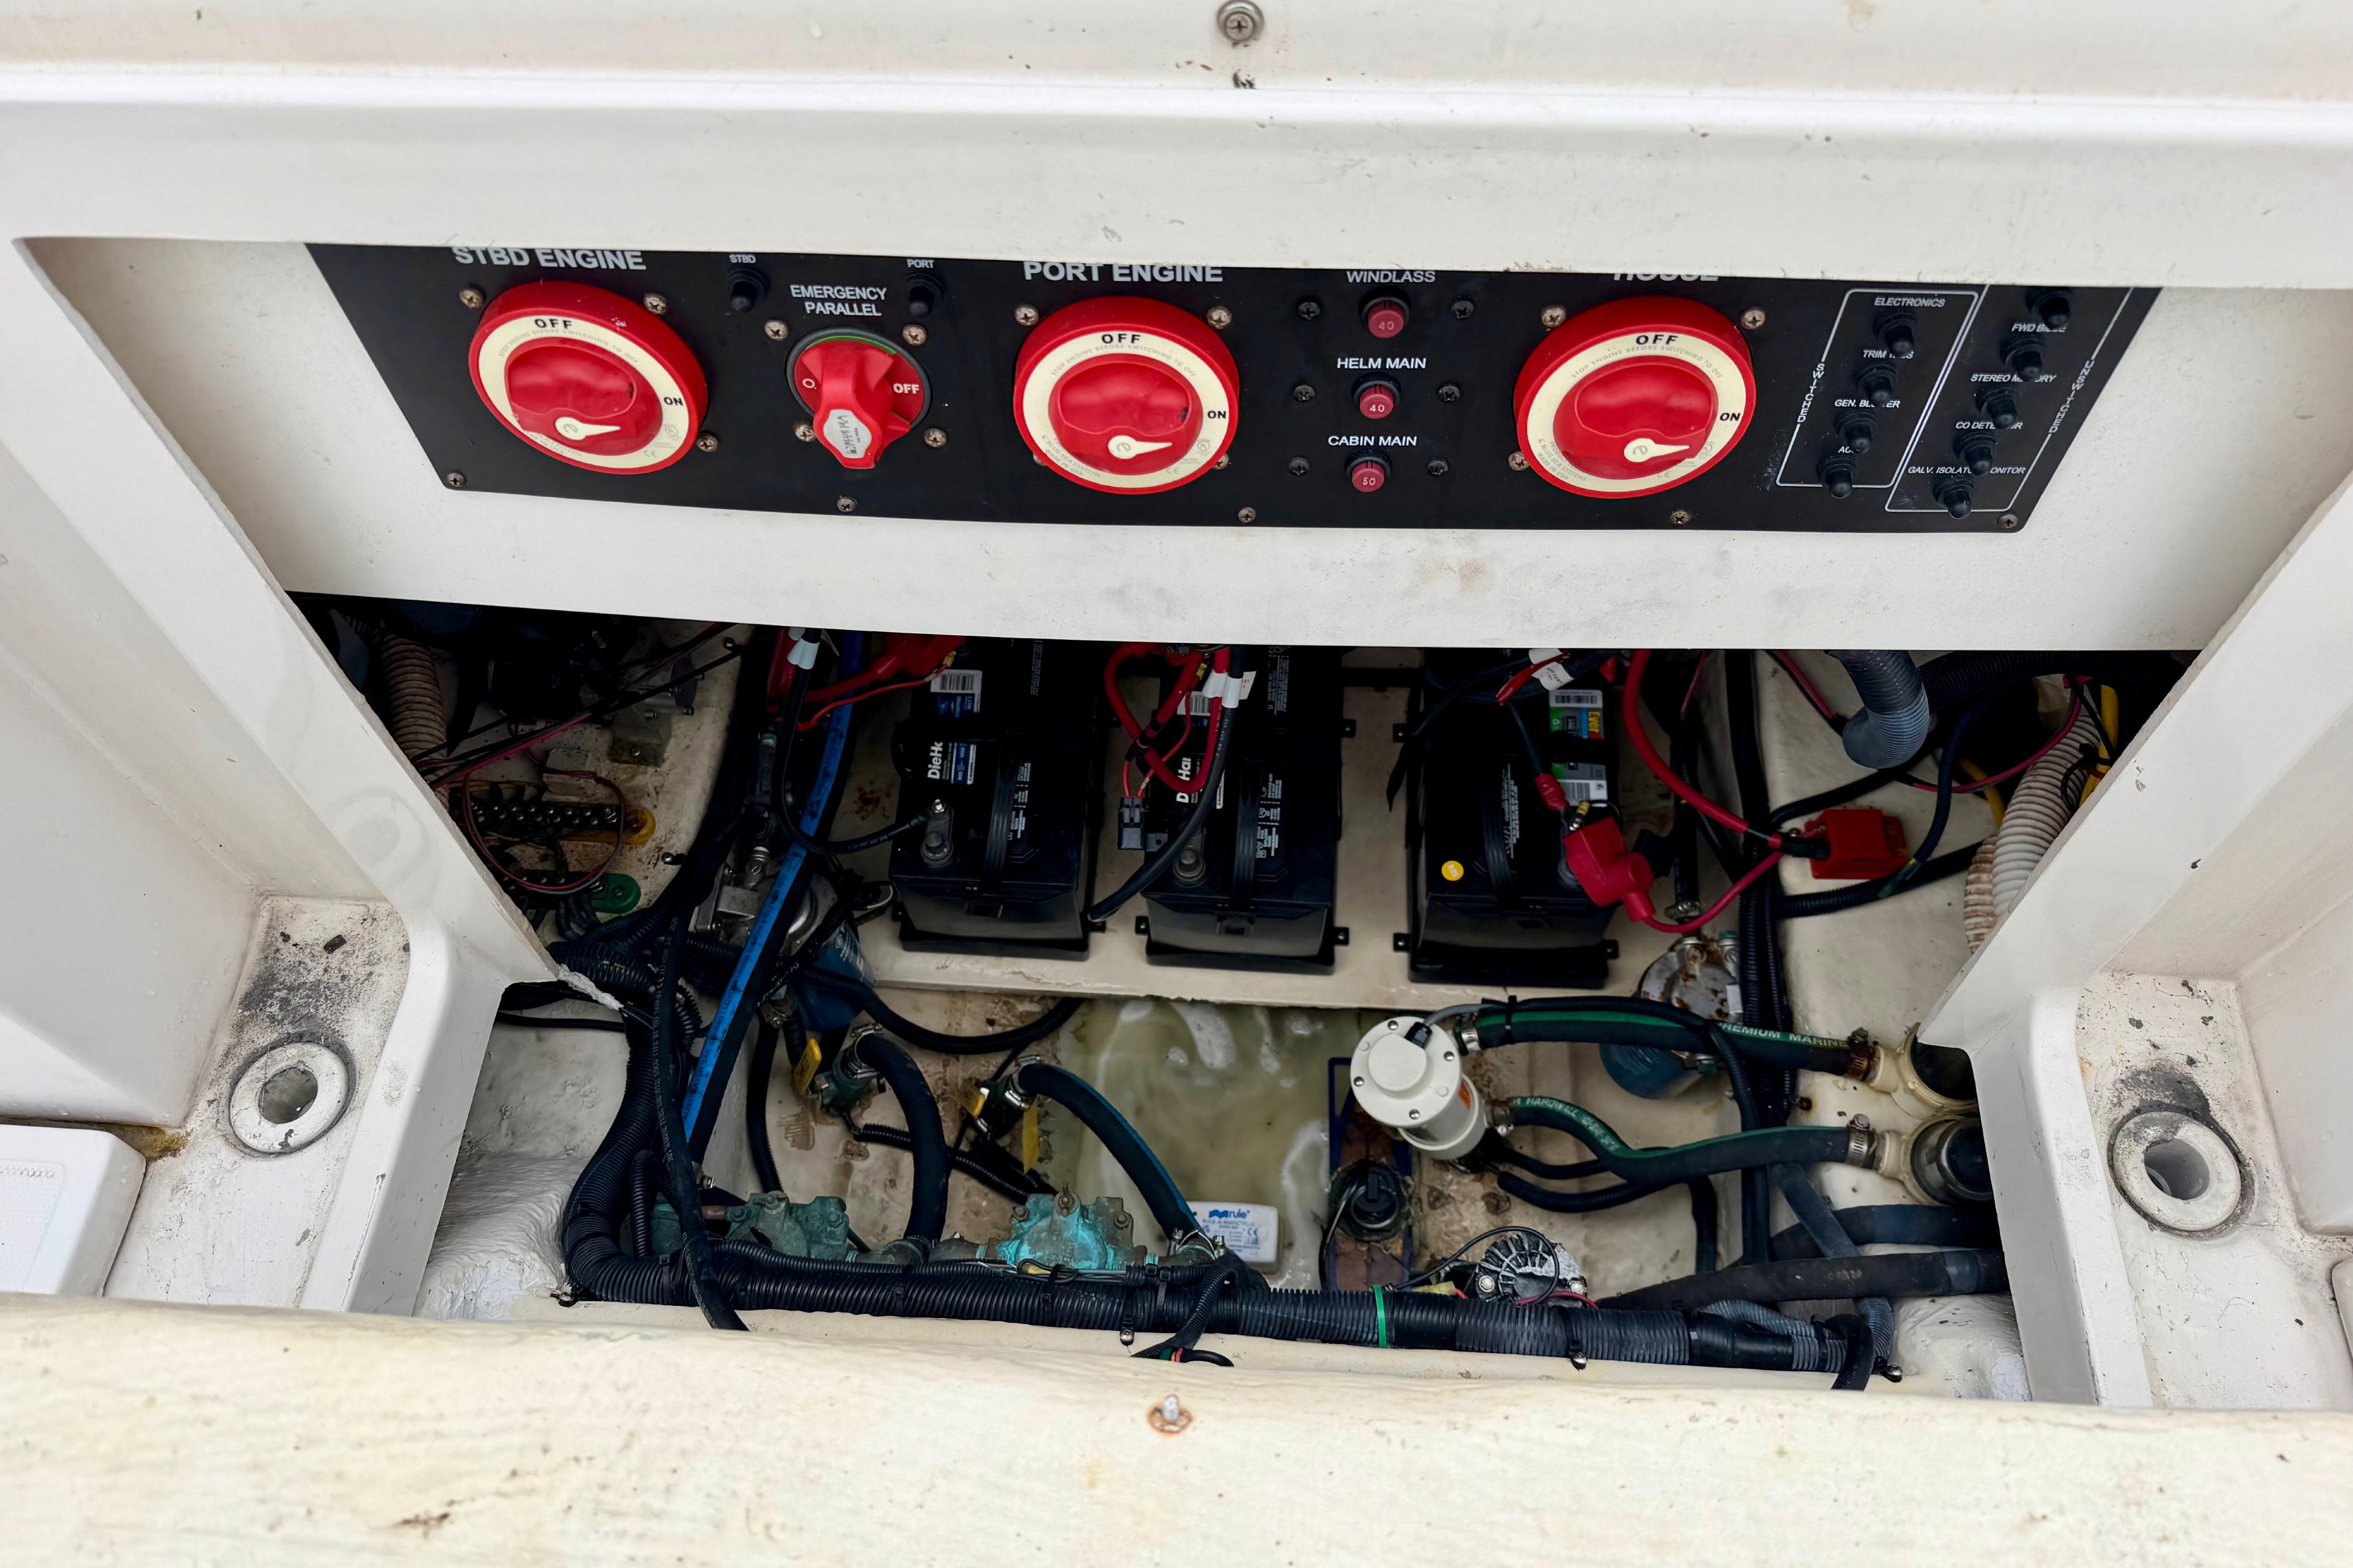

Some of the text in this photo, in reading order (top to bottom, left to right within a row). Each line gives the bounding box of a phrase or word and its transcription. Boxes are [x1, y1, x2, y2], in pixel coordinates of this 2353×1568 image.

[453, 247, 647, 270] STBD ENGINE
[729, 255, 756, 263] STBD
[907, 260, 934, 268] PORT
[1023, 262, 1223, 282] PORT ENGINE
[1346, 271, 1435, 283] WINDLASS
[790, 284, 887, 300] EMERGENCY
[1874, 297, 1945, 307] ELECTRONICS
[805, 302, 882, 316] PARALLEL
[534, 319, 572, 329] OFF
[1378, 321, 1394, 330] 40
[1102, 333, 1141, 344] OFF
[1636, 334, 1678, 345] OFF
[1661, 345, 1703, 362] SWITCHING
[1863, 350, 1887, 358] TRIM
[1336, 357, 1427, 369] HELM MAIN
[893, 384, 920, 393] OFF
[1797, 363, 1825, 422] SWITCHED
[664, 396, 684, 406] ON
[2048, 360, 2095, 433] UNSWITCHED
[1369, 404, 1385, 413] 40
[1208, 410, 1226, 419] ON
[1720, 412, 1741, 421] ON
[1328, 436, 1417, 446] CABIN MAIN
[1788, 1033, 1850, 1049] MARINE
